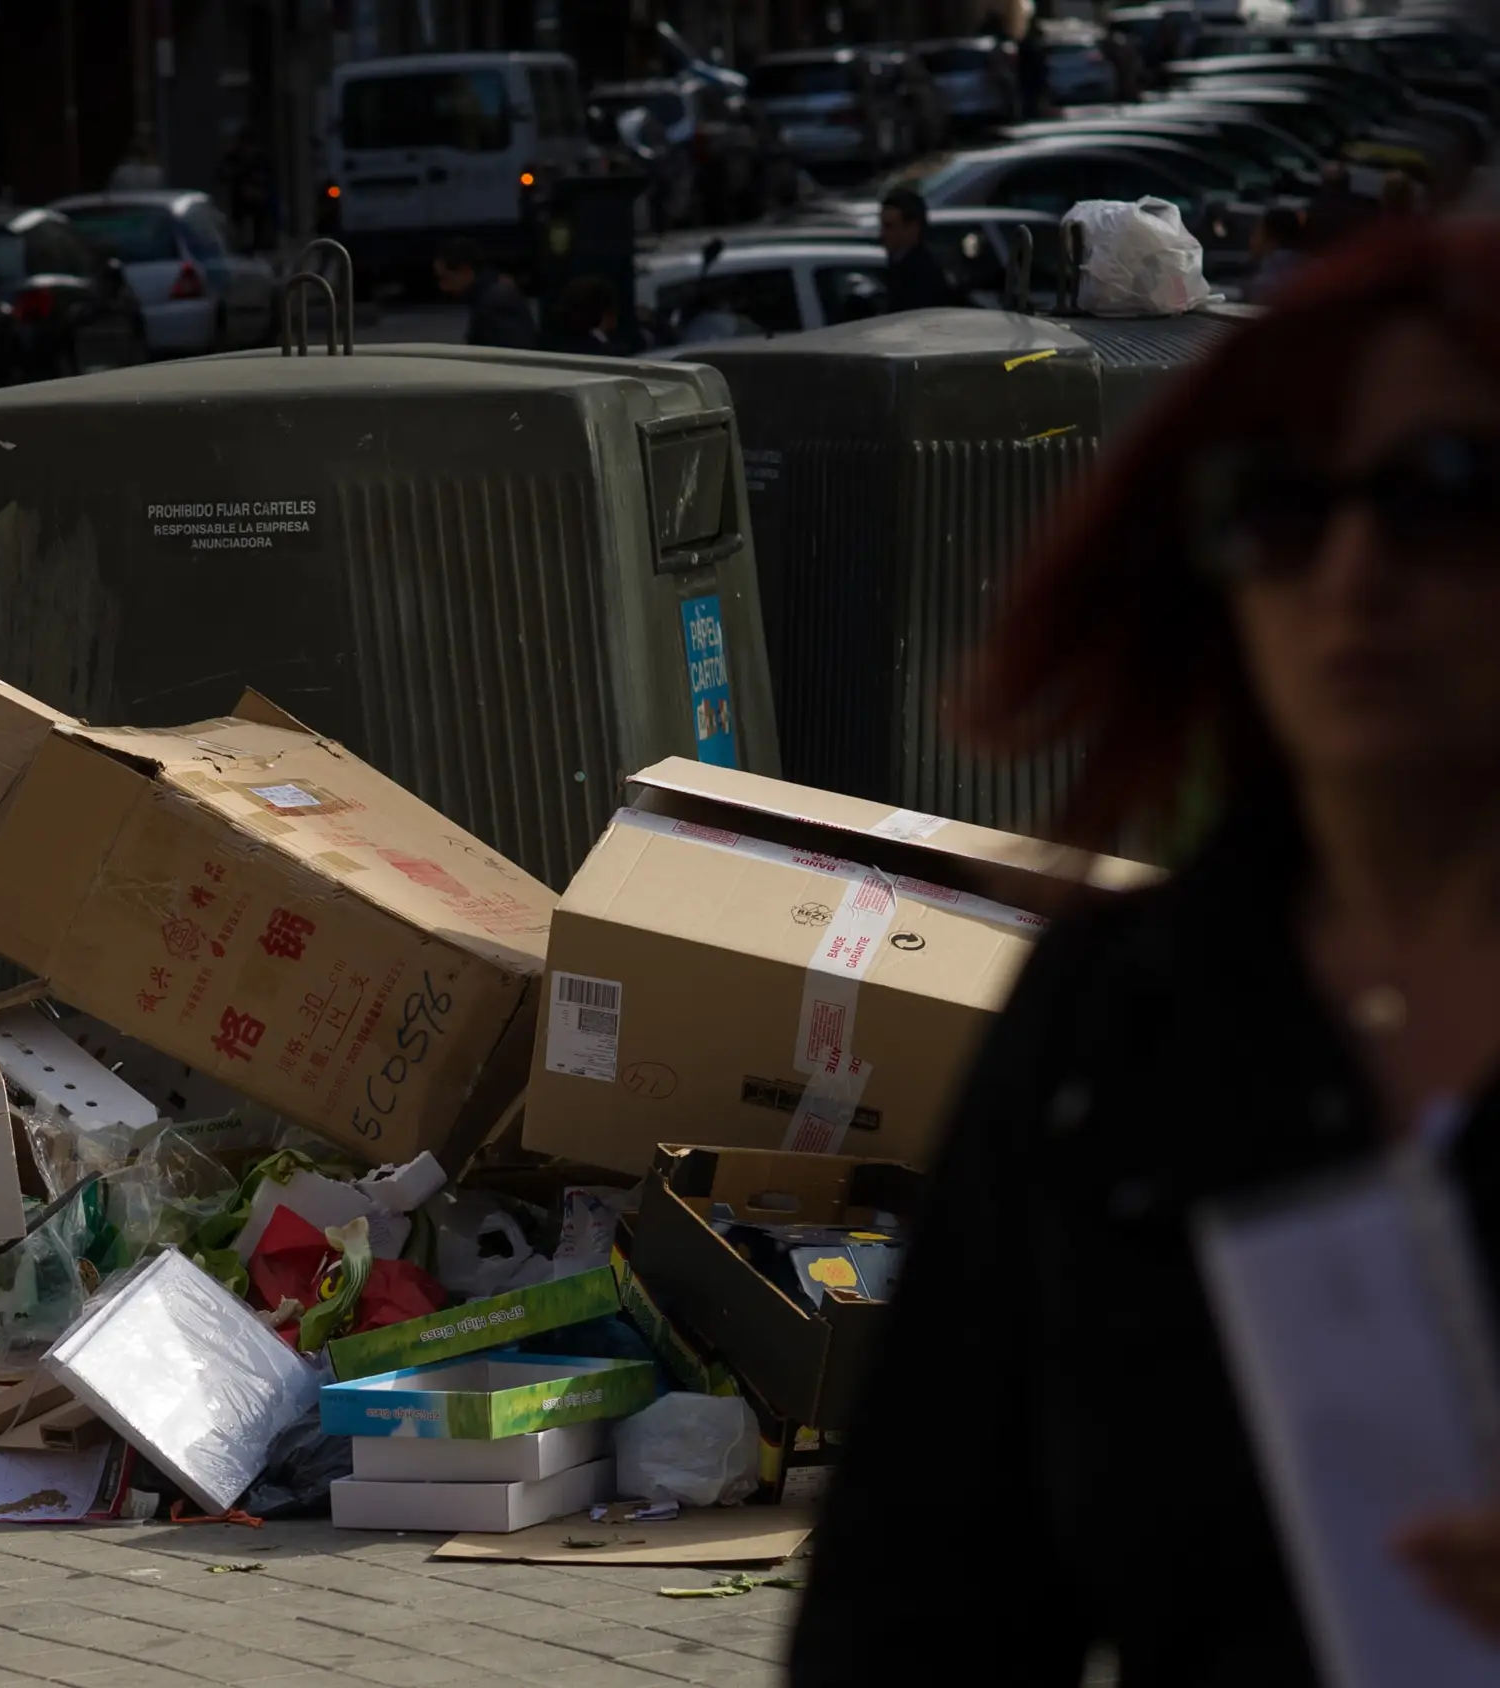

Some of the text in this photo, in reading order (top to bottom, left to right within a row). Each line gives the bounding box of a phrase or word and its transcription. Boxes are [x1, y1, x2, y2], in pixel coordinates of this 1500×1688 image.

[147, 500, 316, 519] PROHIBIDO FIJAR CARTELES
[154, 520, 310, 536] RESPONSABLE LA EMPRESA
[190, 536, 273, 550] ANUNCIADORA
[690, 615, 719, 651] PAPEL
[791, 855, 837, 873] BANDE
[826, 935, 847, 958] BANDE
[846, 936, 870, 969] GARANTIE
[207, 1118, 242, 1132] OKRA
[419, 1305, 525, 1343] 6PCS High Class
[414, 1410, 440, 1421] 6PCS
